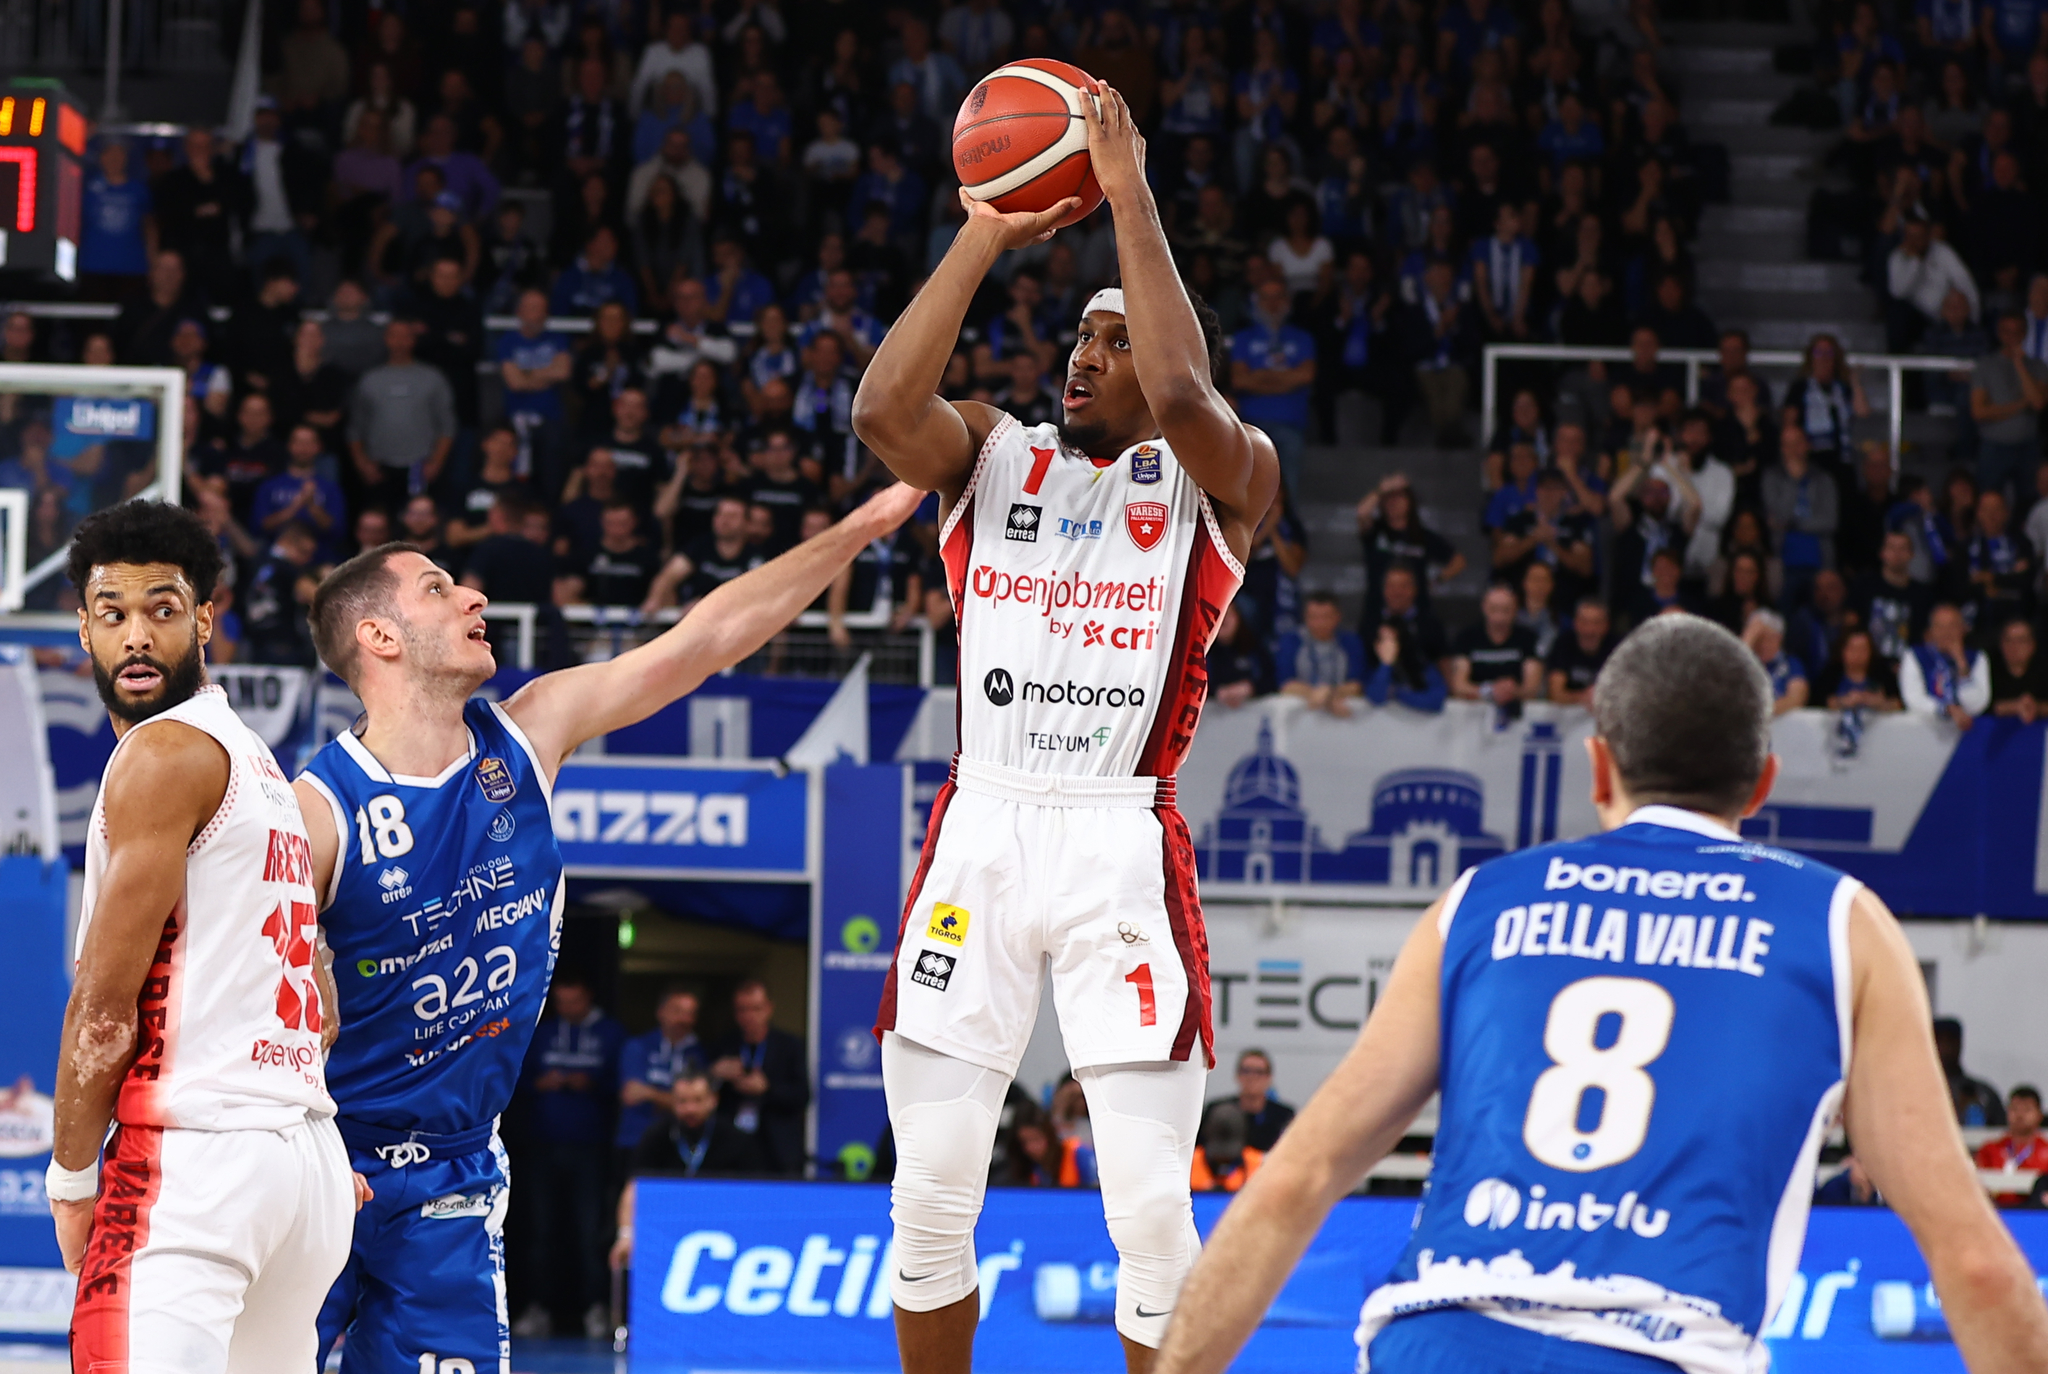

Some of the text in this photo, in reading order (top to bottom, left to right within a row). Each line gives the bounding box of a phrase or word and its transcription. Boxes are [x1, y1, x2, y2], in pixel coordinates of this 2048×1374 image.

[1022, 445, 1056, 496] 1
[1135, 459, 1158, 468] LBA
[1136, 472, 1157, 481] Unipol
[1130, 505, 1164, 517] VARESE
[1050, 617, 1160, 650] by cri
[1022, 680, 1145, 708] motoroa
[481, 769, 506, 784] LBA
[356, 794, 415, 866] 18
[460, 854, 511, 887] MROLOGIA
[1544, 857, 1757, 903] bonera.
[930, 926, 962, 942] TIGROS
[1491, 901, 1775, 978] DELLA VALLE
[412, 945, 517, 1021] a2a
[1125, 963, 1156, 1027] 1
[415, 992, 511, 1040] LIFE COMANY
[1523, 975, 1676, 1173] 8
[83, 1157, 150, 1302] VARESE
[660, 1231, 1022, 1322] Cetilr
